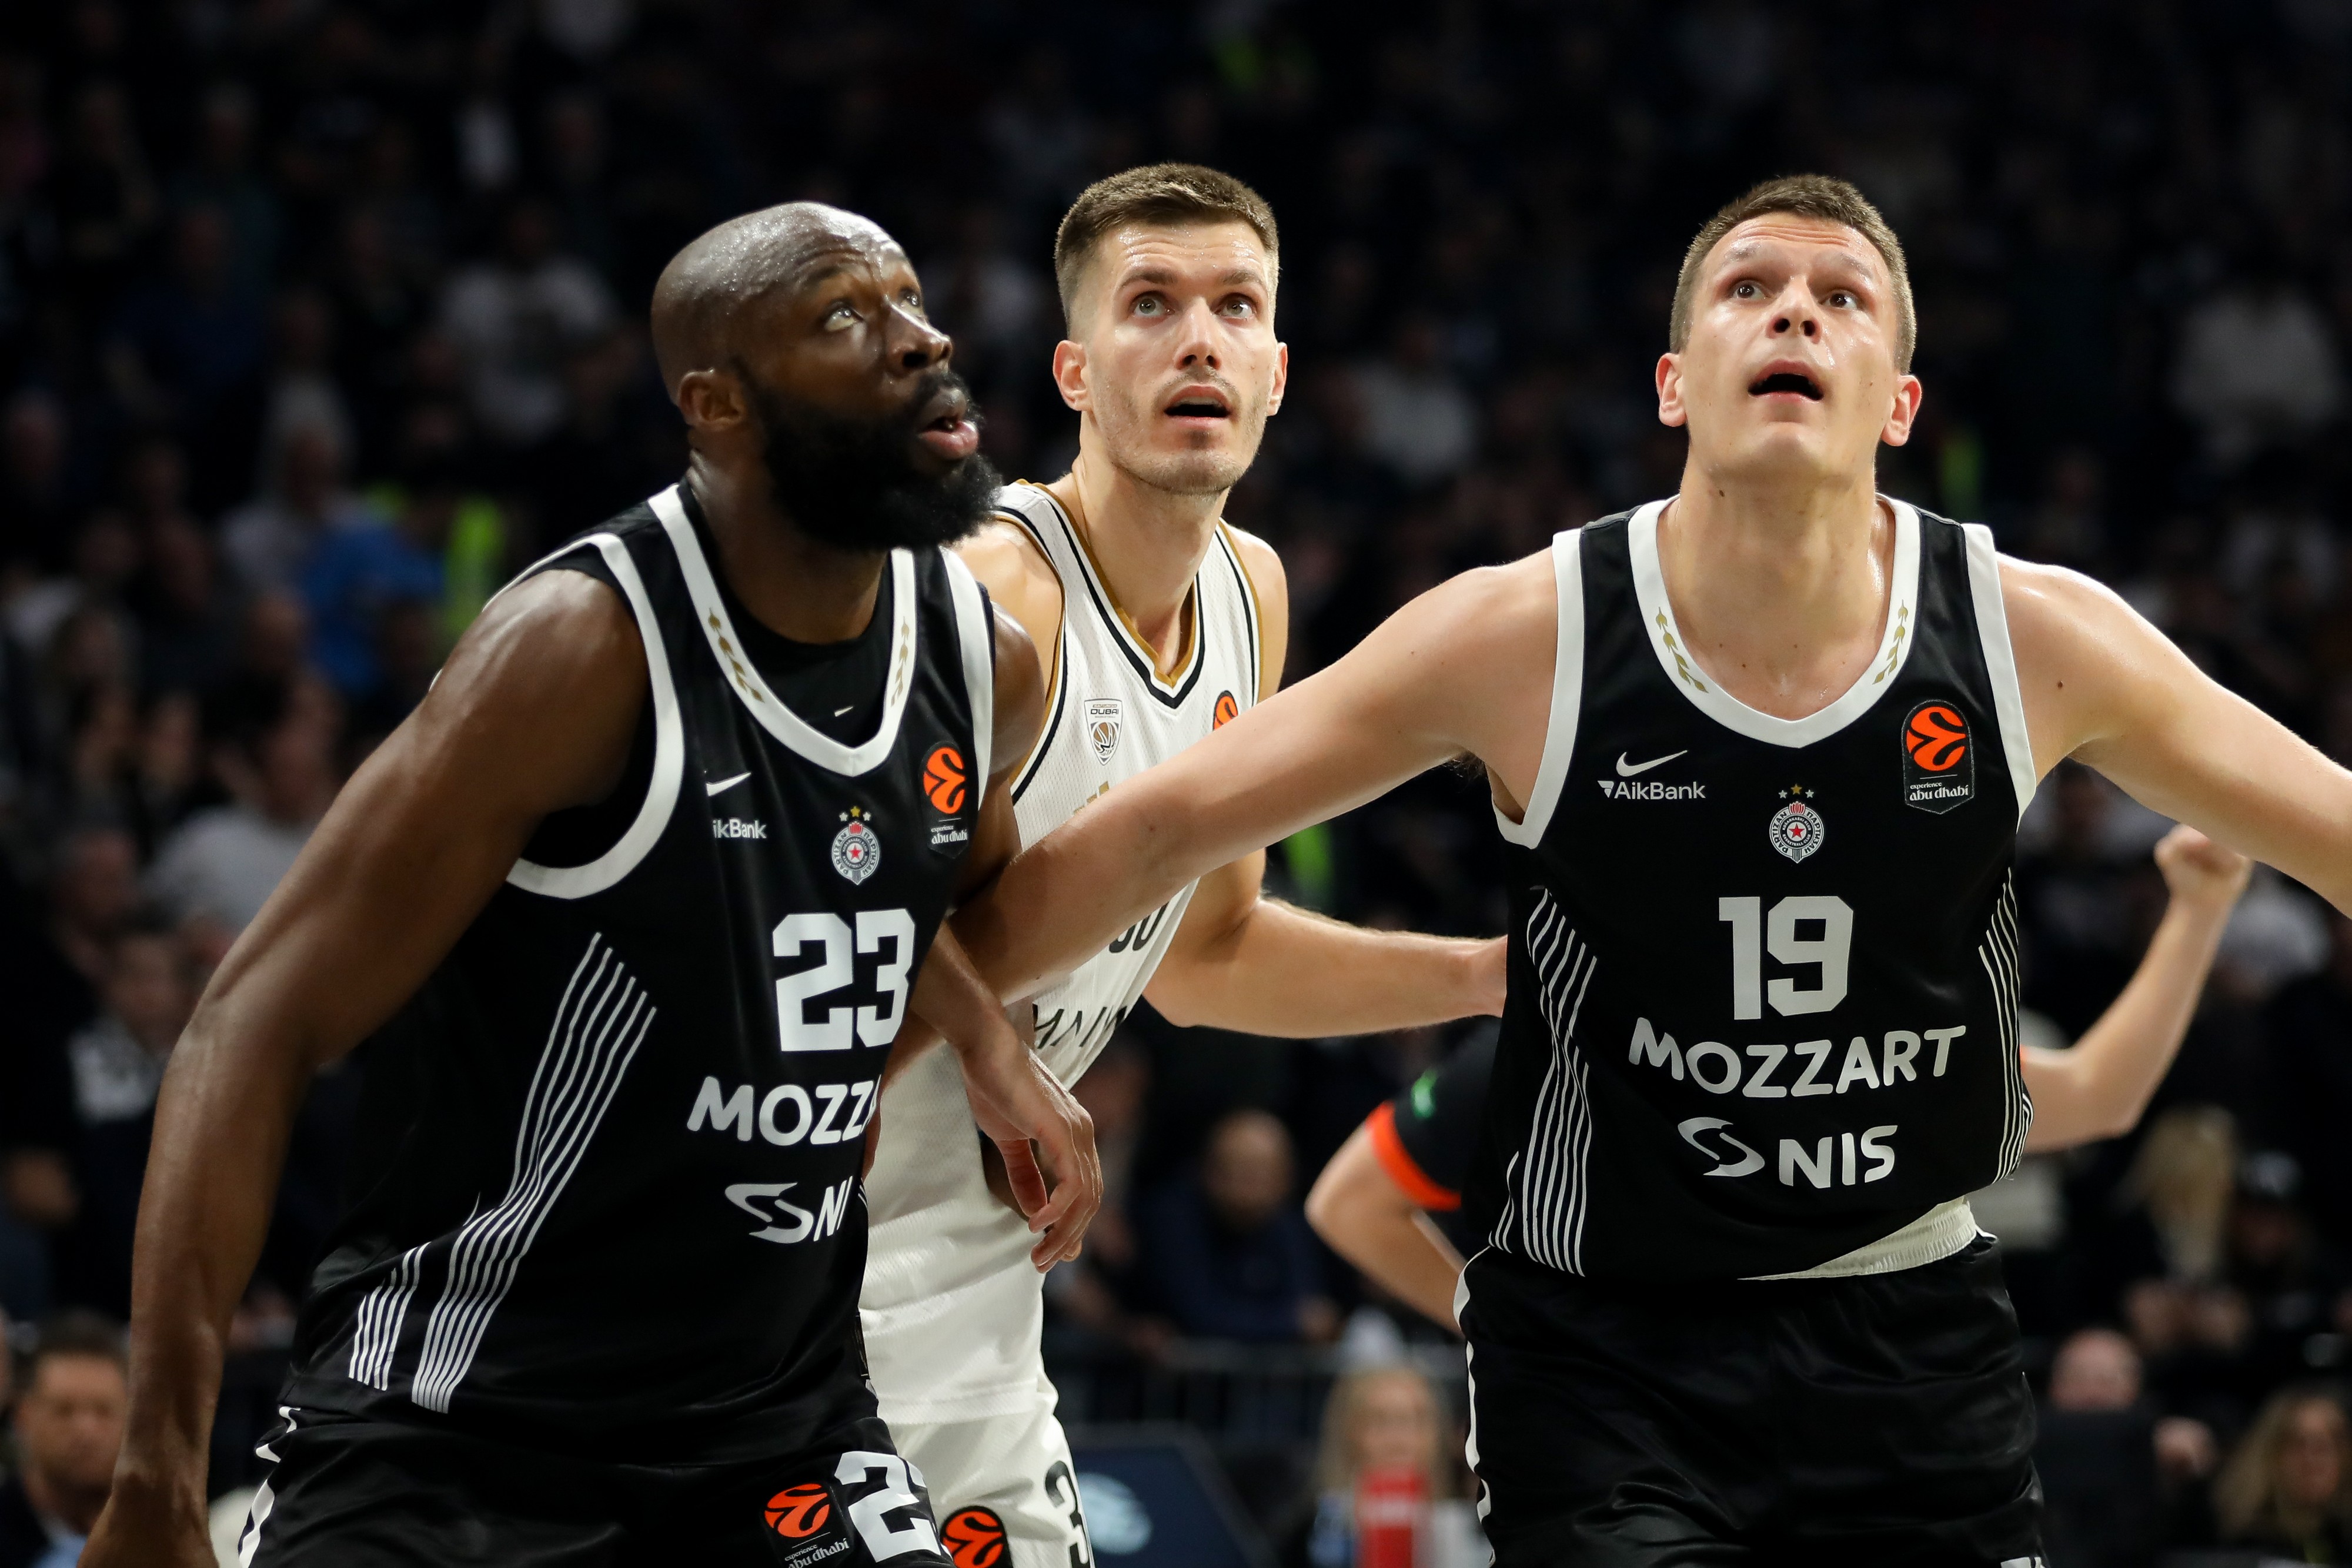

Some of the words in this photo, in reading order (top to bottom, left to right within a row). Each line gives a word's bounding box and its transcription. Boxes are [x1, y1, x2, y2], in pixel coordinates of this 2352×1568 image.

[1614, 781, 1706, 800] AikBank
[1909, 790, 1933, 801] abu
[712, 819, 767, 838] ikBank
[931, 833, 948, 844] abu
[1772, 812, 1788, 854] PARTIZAN
[1805, 811, 1821, 854] ПАРТИЗАН
[833, 832, 848, 875] PARTIZAN
[863, 831, 877, 875] ПАРТИЗАН
[1719, 895, 1853, 1021] 19
[772, 908, 916, 1052] 23
[1628, 1017, 1966, 1098] MOZZART
[1779, 1125, 1898, 1189] NIS
[813, 1176, 853, 1242] NI
[834, 1451, 953, 1563] 2
[785, 1544, 817, 1561] experience
